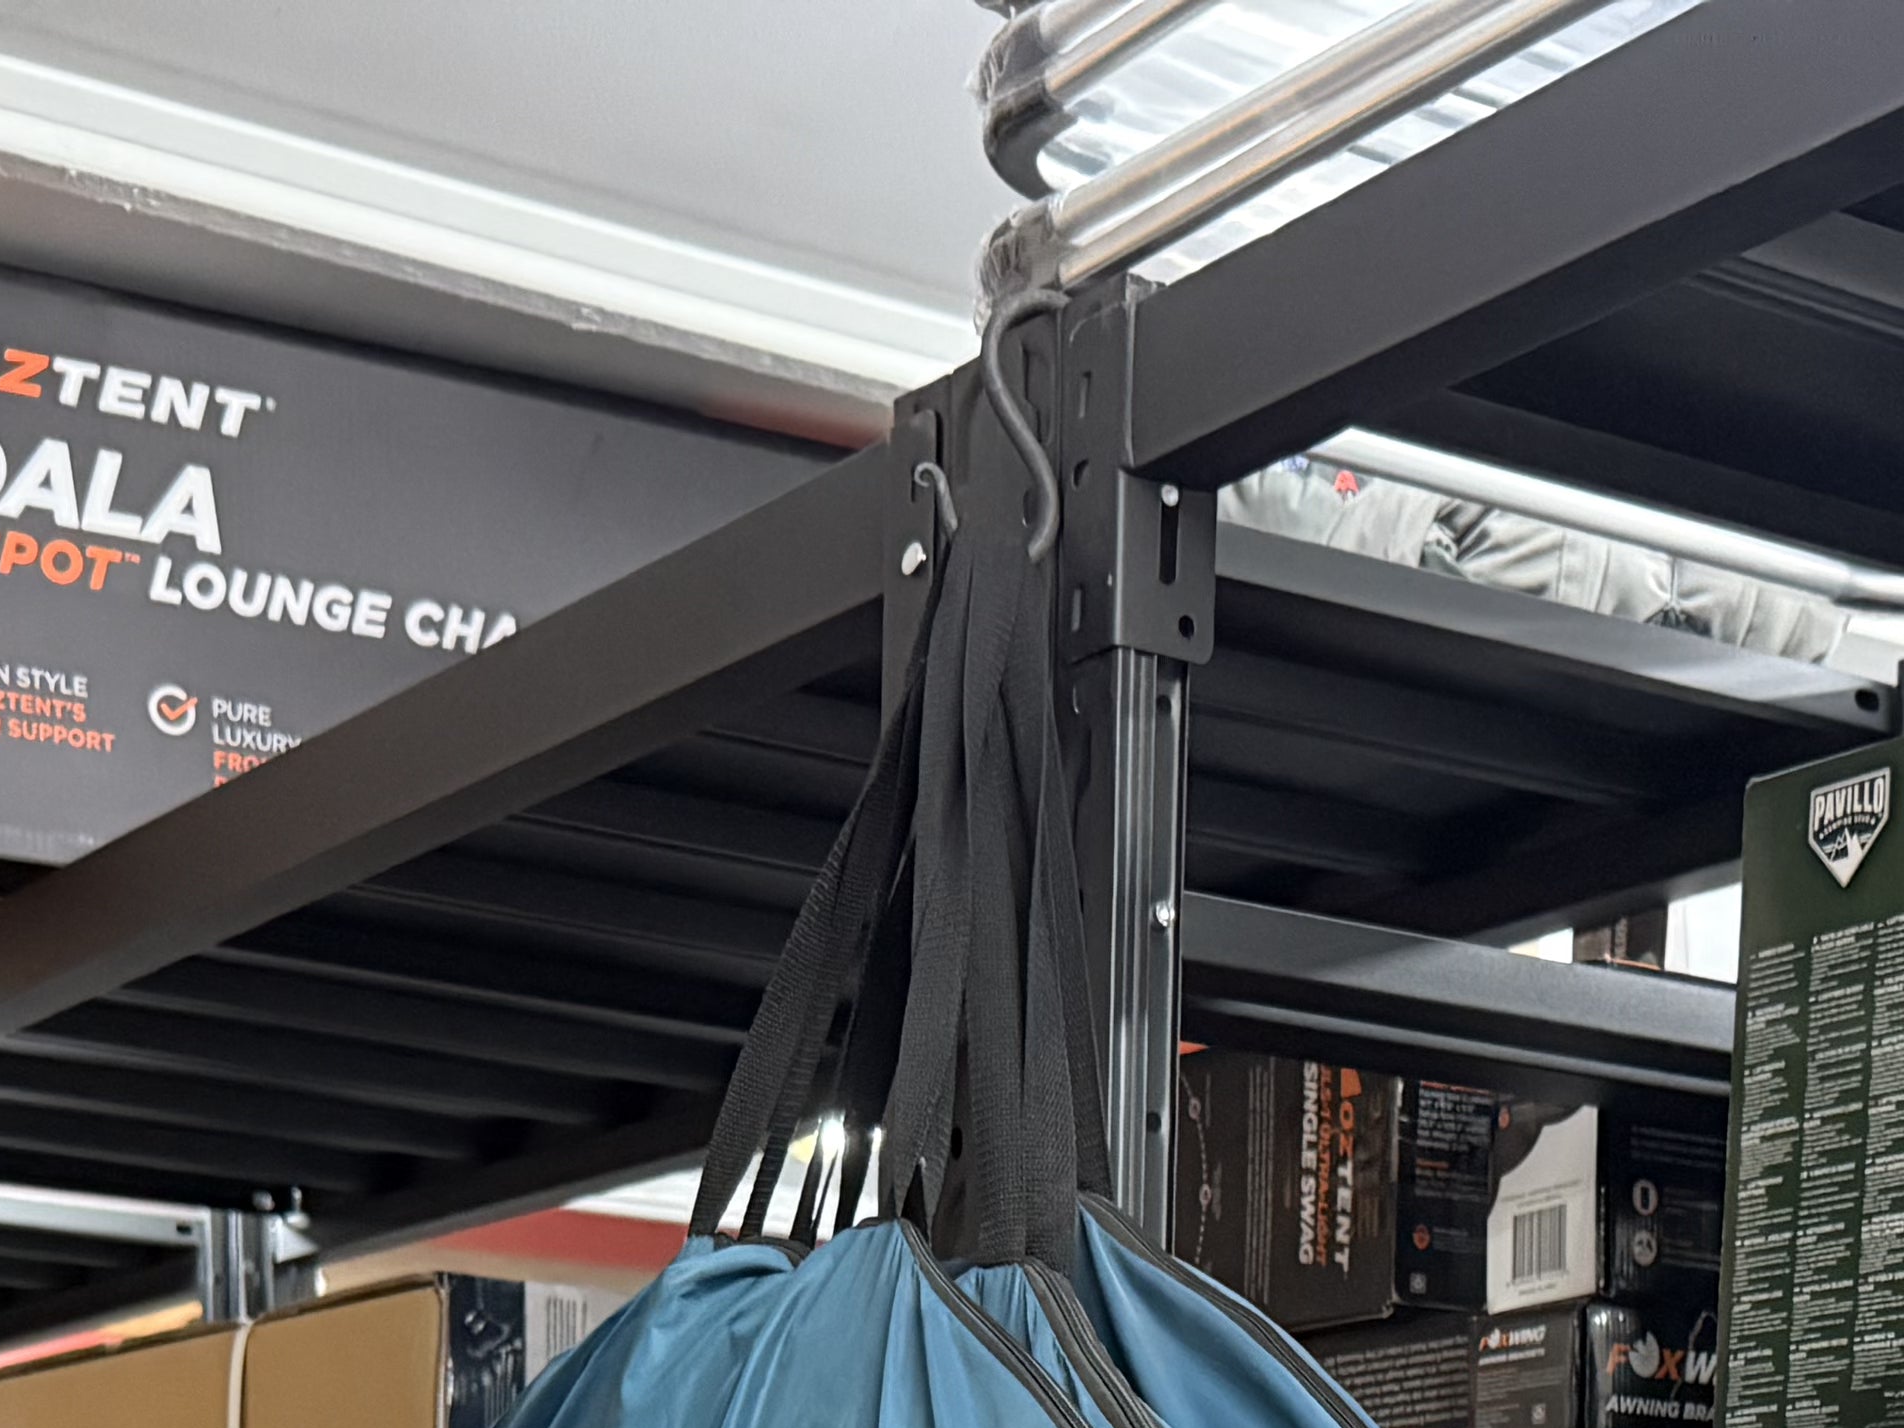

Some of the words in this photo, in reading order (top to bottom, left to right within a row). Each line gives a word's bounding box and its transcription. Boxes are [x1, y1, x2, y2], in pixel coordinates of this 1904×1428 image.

[149, 554, 392, 639] LOUNGE
[15, 667, 88, 698] STYLE
[8, 718, 115, 752] SUPPORT
[212, 696, 271, 727] PURE
[1812, 778, 1886, 835] PAVILLO
[1302, 1061, 1319, 1171] SINGLE
[1335, 1101, 1354, 1273] OZTENT
[1299, 1173, 1317, 1264] SWAG
[1606, 1396, 1679, 1418] AWNING
